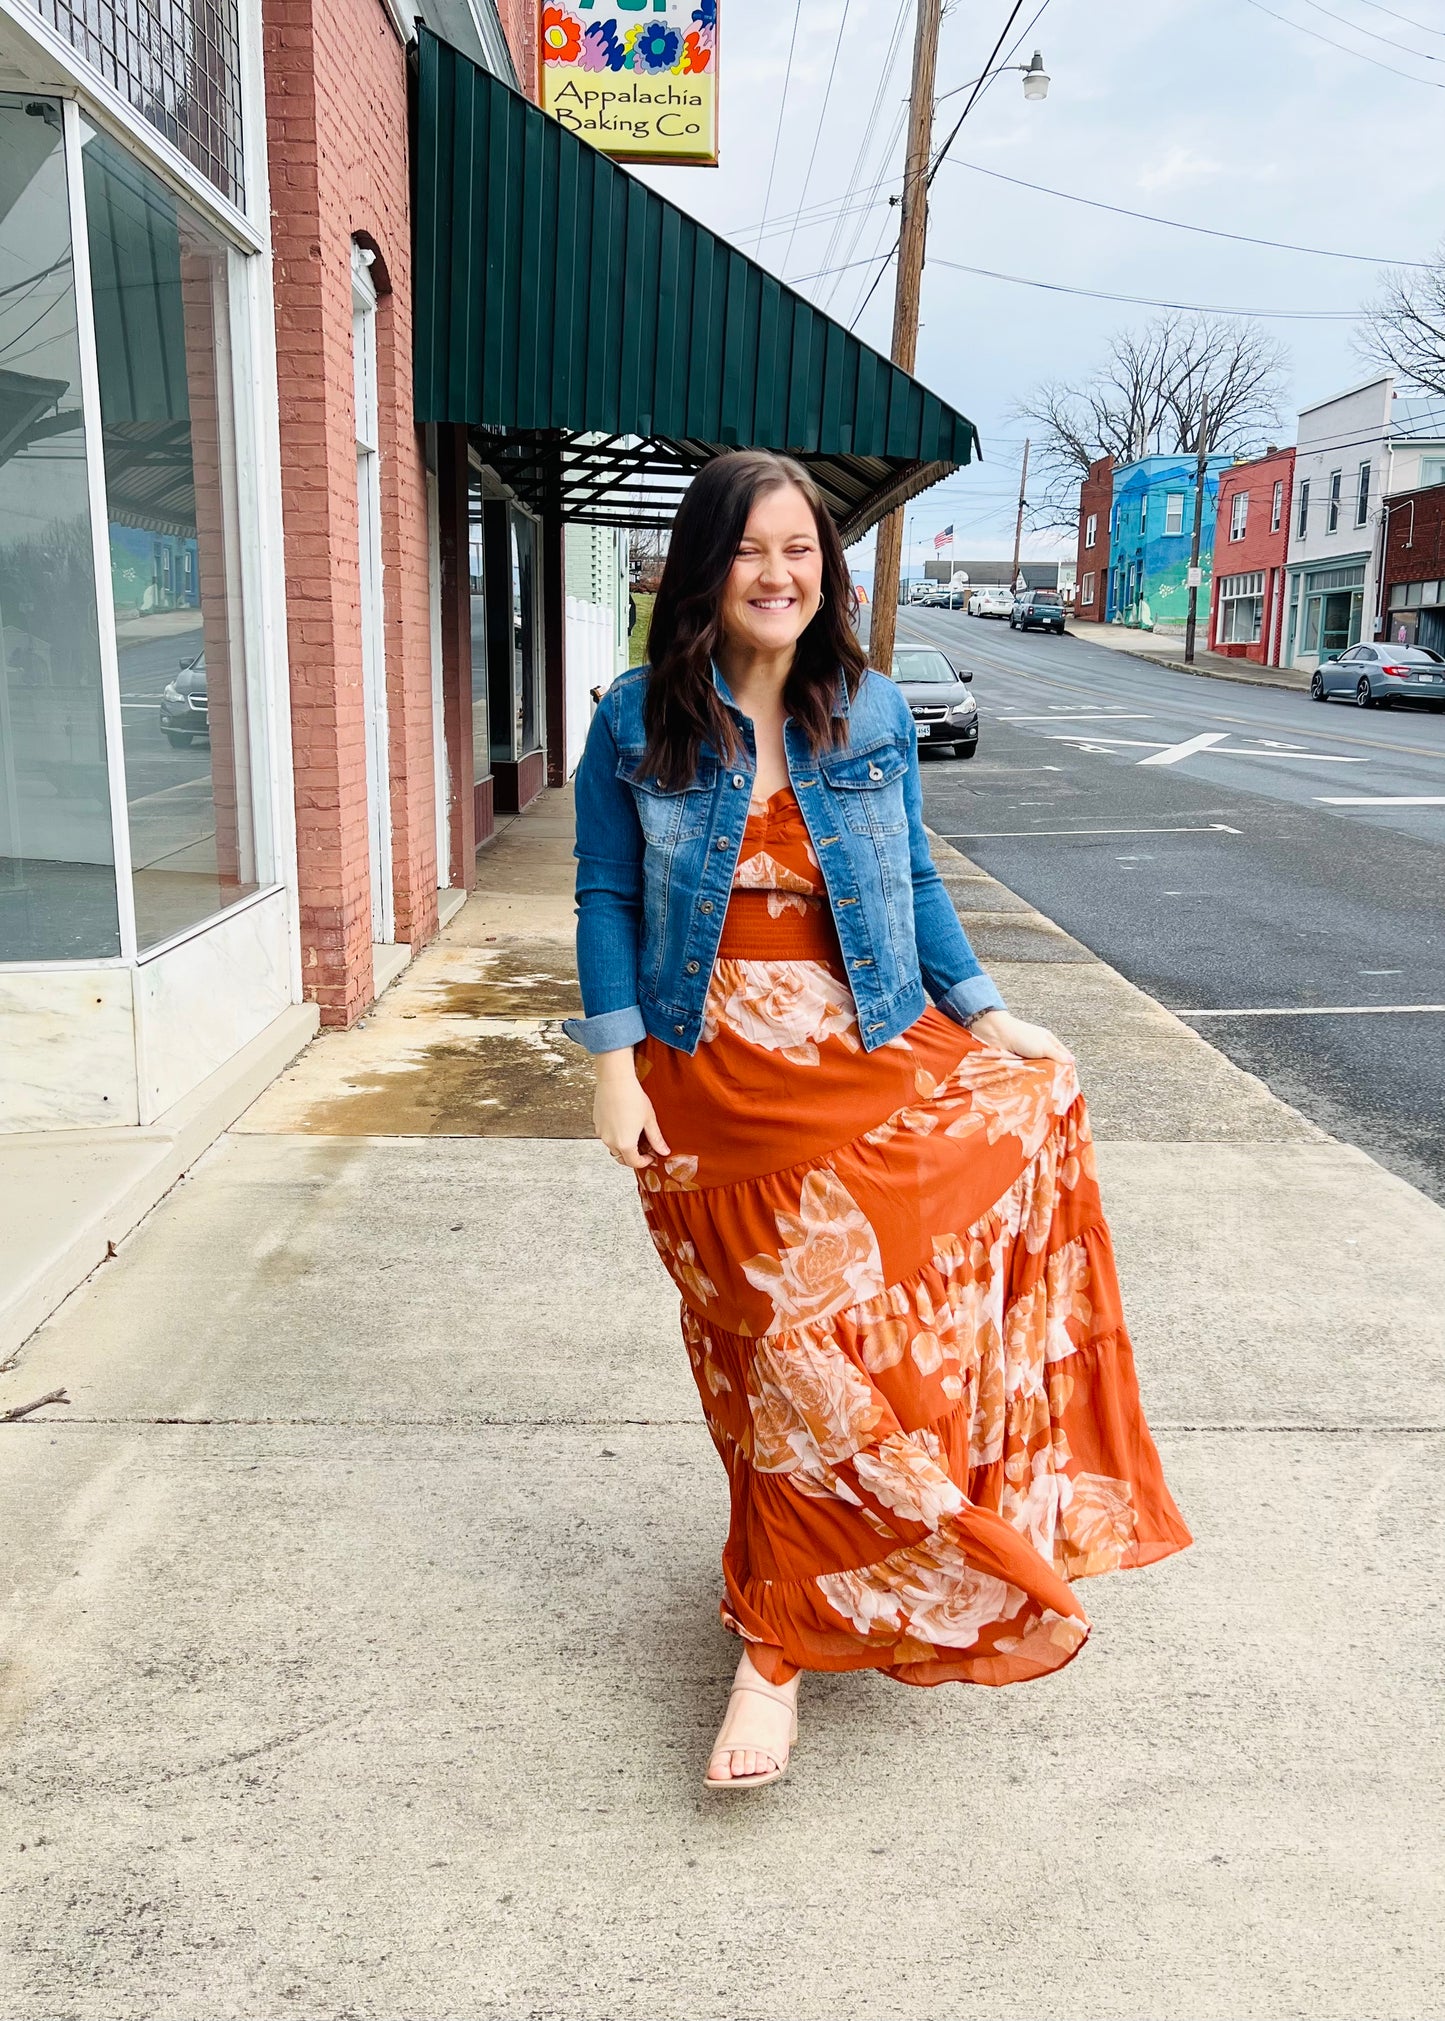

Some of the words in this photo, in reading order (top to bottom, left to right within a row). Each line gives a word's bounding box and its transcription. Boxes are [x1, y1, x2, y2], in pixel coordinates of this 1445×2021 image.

[554, 81, 702, 110] Appalachia
[555, 108, 649, 138] Baking
[656, 113, 700, 137] Co
